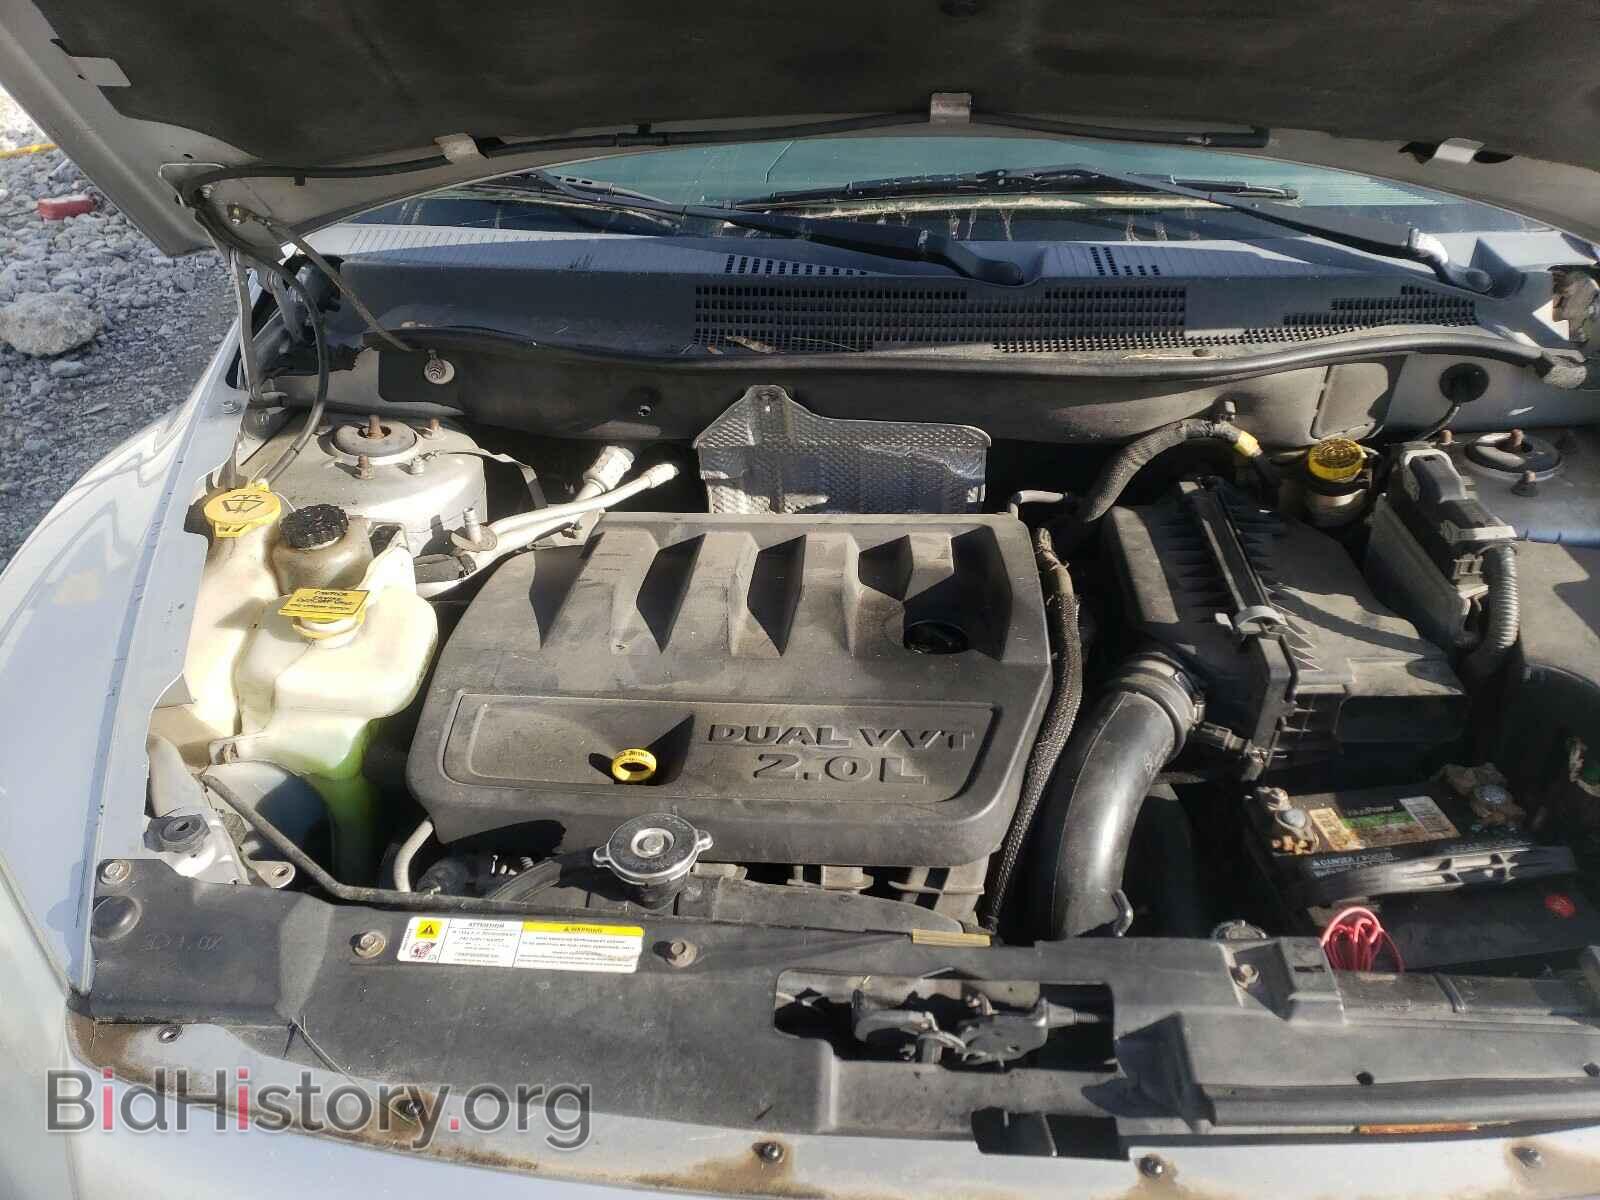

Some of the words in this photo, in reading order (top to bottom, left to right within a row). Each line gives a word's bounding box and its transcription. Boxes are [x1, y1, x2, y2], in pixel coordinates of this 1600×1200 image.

[708, 723, 851, 748] DUAL
[857, 727, 976, 750] VVT
[753, 753, 929, 785] 2.0L
